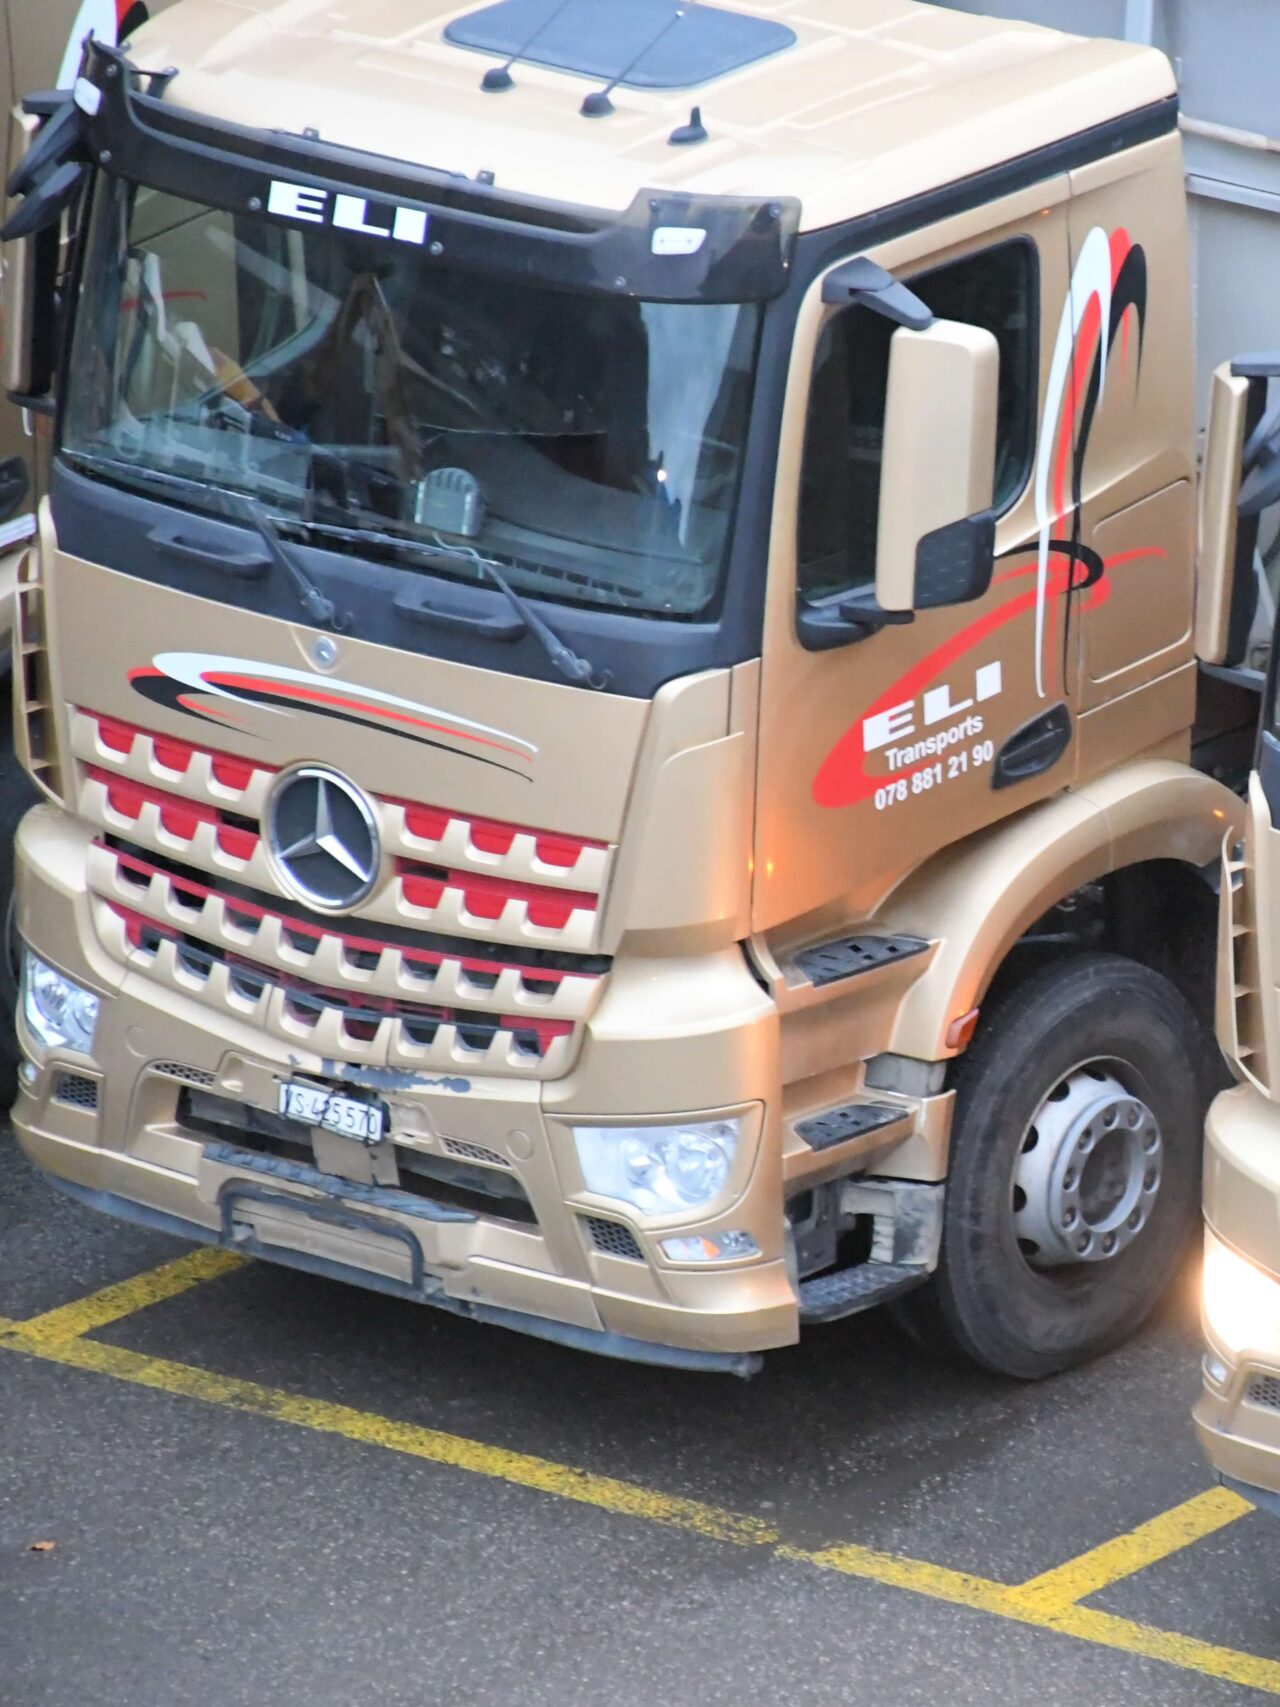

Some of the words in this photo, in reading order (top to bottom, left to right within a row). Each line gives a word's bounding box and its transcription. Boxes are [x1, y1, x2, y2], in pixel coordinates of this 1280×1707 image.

[267, 180, 427, 245] ELI
[862, 661, 1001, 752] ELI
[874, 778, 907, 810] 078
[911, 767, 943, 794] 881
[948, 751, 968, 777] 21
[972, 740, 994, 766] 90
[885, 715, 984, 771] Transports
